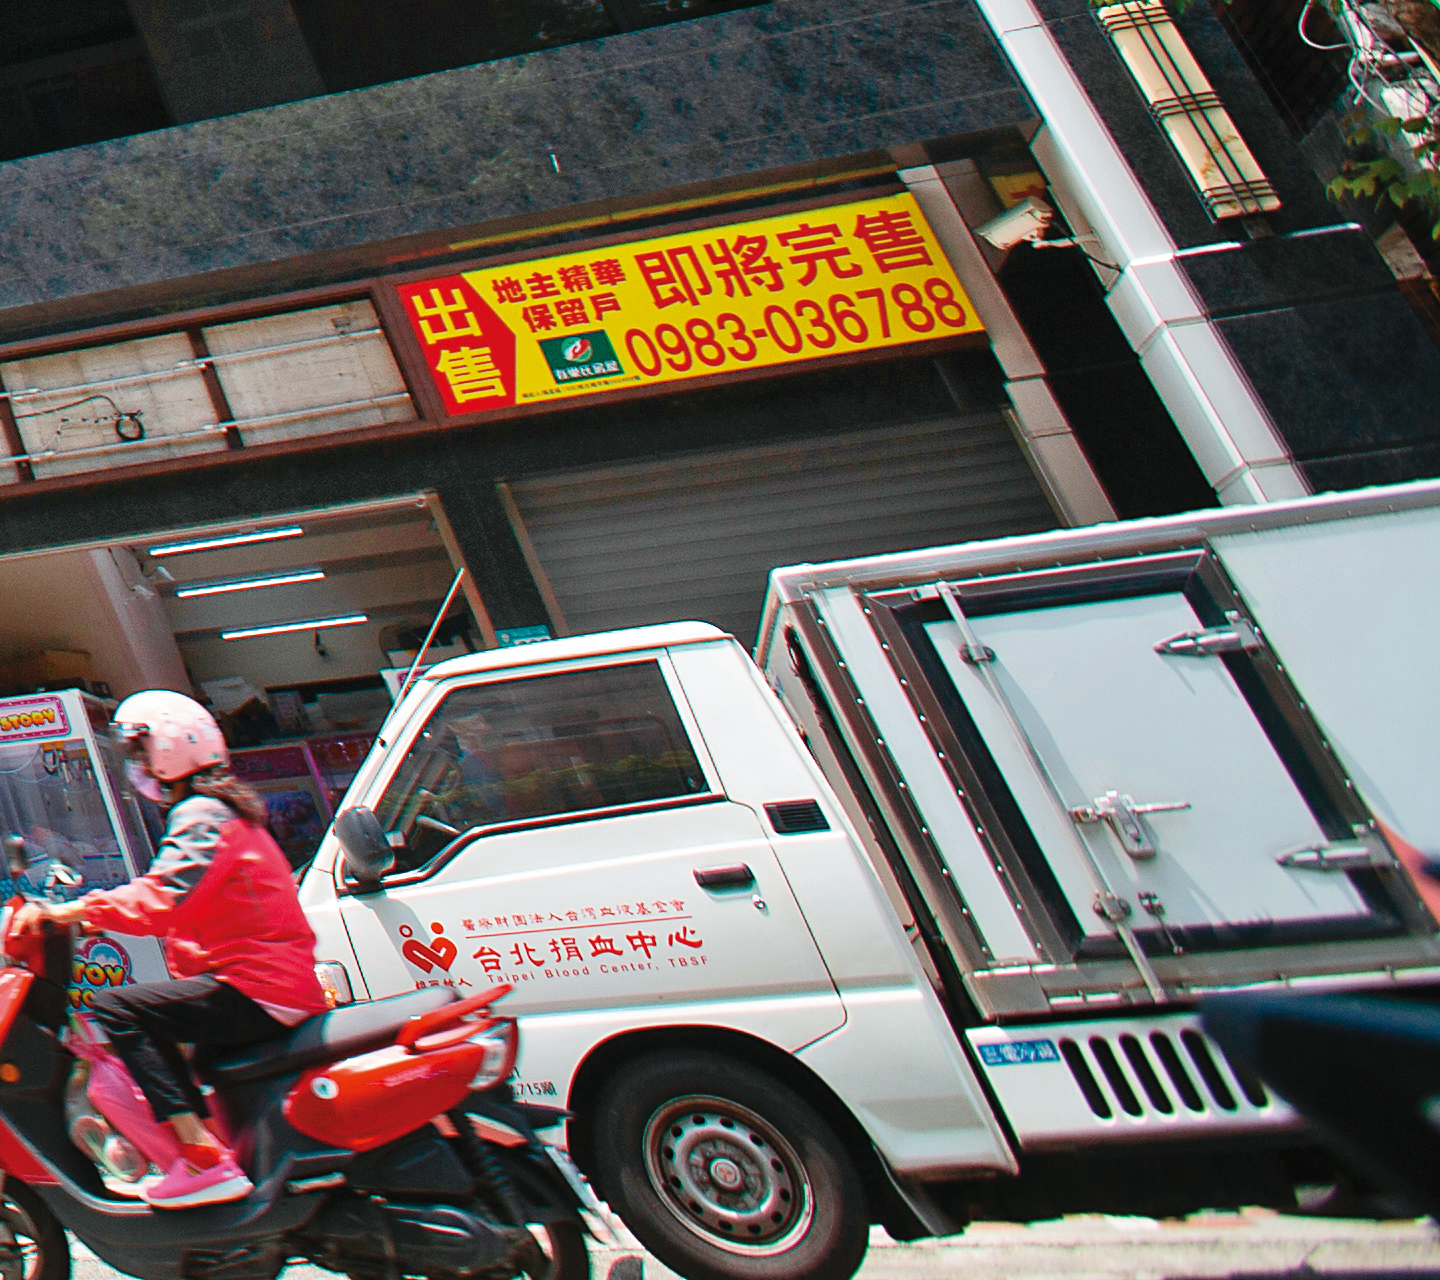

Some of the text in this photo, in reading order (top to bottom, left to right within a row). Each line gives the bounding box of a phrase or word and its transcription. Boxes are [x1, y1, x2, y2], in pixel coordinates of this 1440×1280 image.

[491, 258, 627, 305] 地主精華
[634, 210, 934, 310] 即將完售
[521, 291, 622, 333] 保留戶
[625, 277, 967, 378] 0983-036788
[411, 287, 508, 405] 出售
[0, 708, 56, 732] STORY
[472, 925, 704, 973] 台北捐血中心
[487, 954, 709, 984] Taipei Blood Center, TBSF
